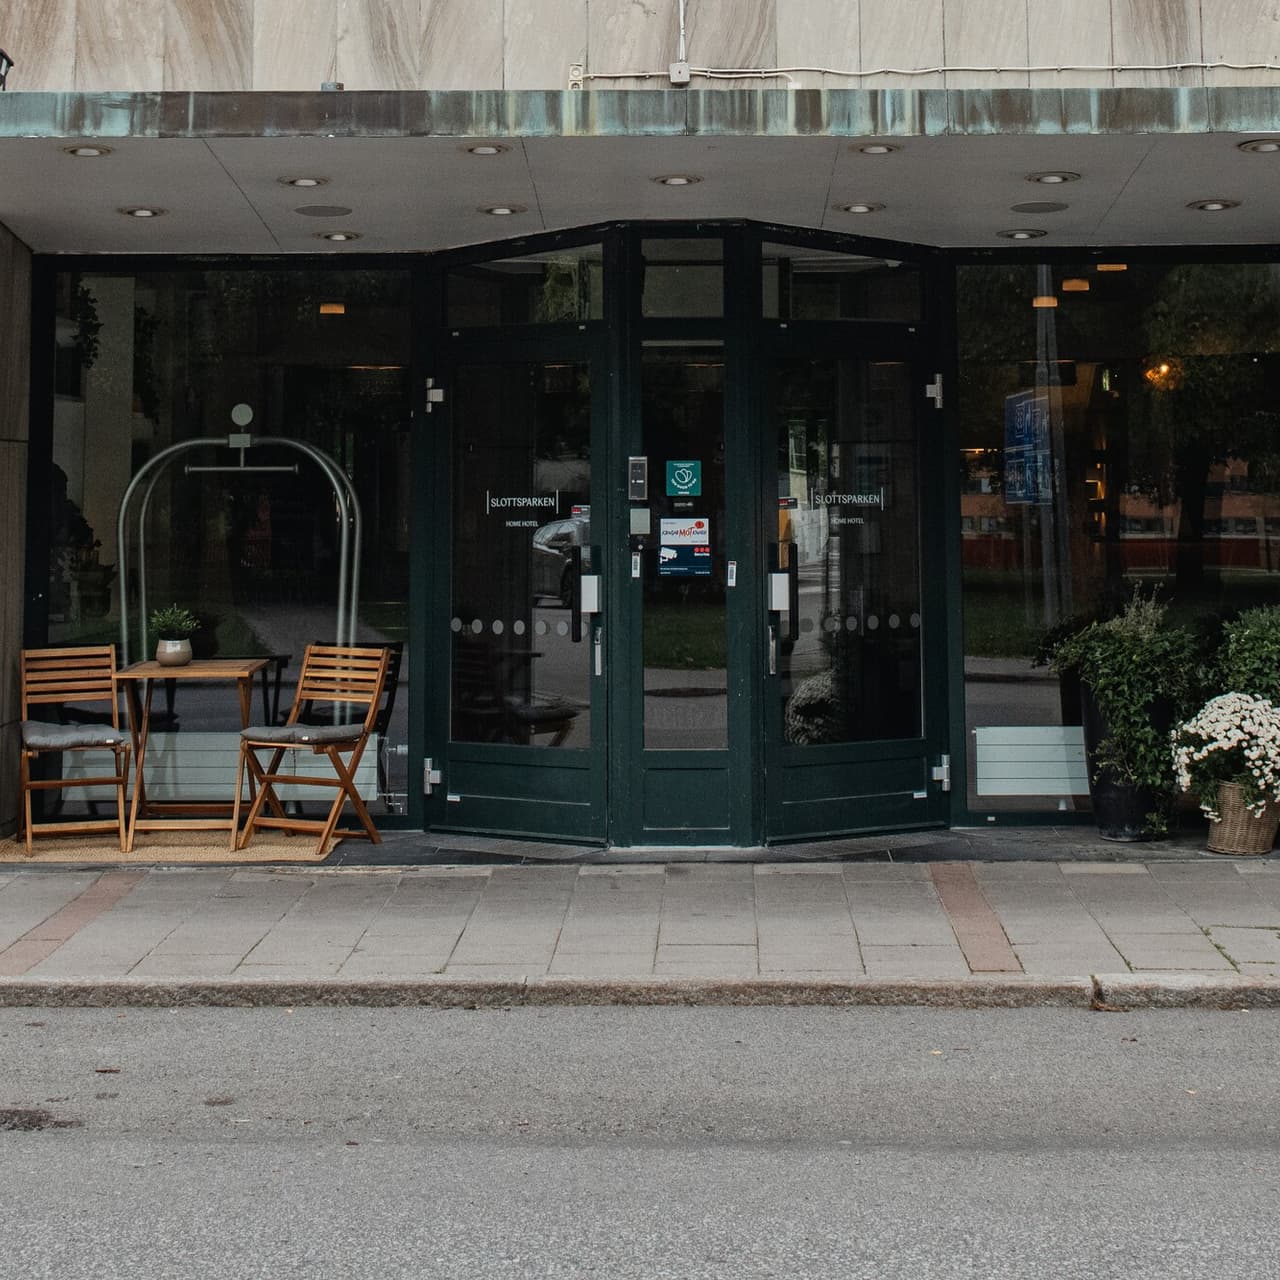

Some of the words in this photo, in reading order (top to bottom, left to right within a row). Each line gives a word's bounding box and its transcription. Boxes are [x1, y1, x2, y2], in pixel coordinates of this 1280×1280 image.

[490, 497, 555, 508] SLOTTSPARKEN
[815, 494, 880, 505] SLOTTSPARKEN
[505, 520, 522, 528] HOME
[522, 520, 539, 528] HOTEL
